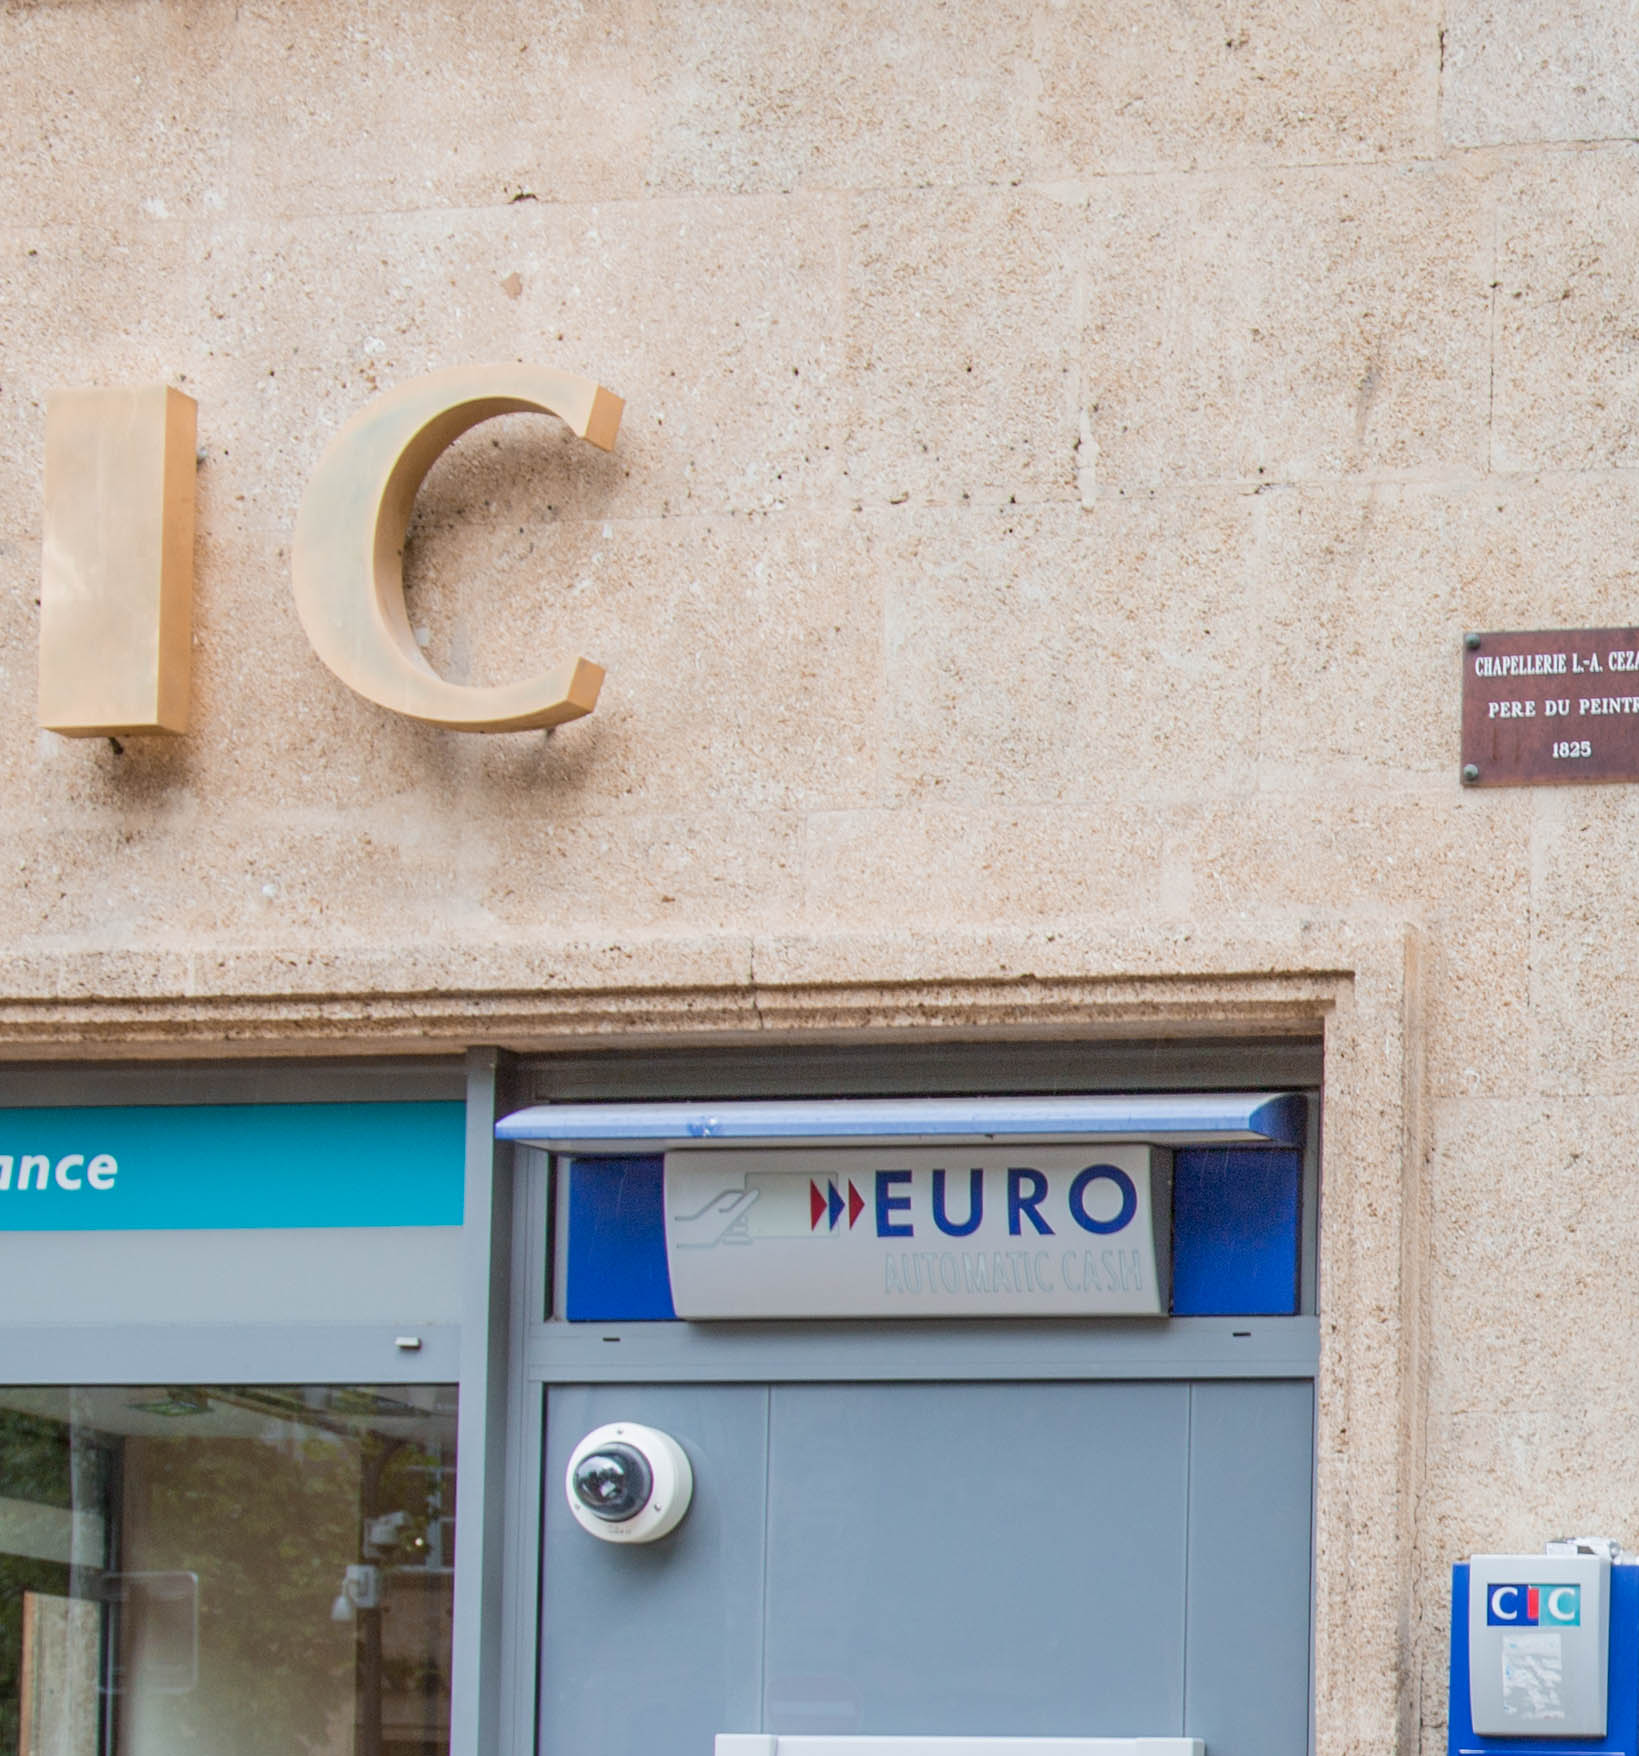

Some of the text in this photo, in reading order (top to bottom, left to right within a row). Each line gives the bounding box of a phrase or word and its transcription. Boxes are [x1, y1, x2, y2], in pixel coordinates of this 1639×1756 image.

[1475, 653, 1567, 677] CHAPELLERIE
[1488, 701, 1536, 718] PERE
[1545, 699, 1570, 717] DU
[1552, 741, 1592, 759] 1825
[875, 1163, 1138, 1238] EURO
[883, 1247, 1144, 1295] AUTOMATIC CASH
[1491, 1586, 1576, 1621] CIC
